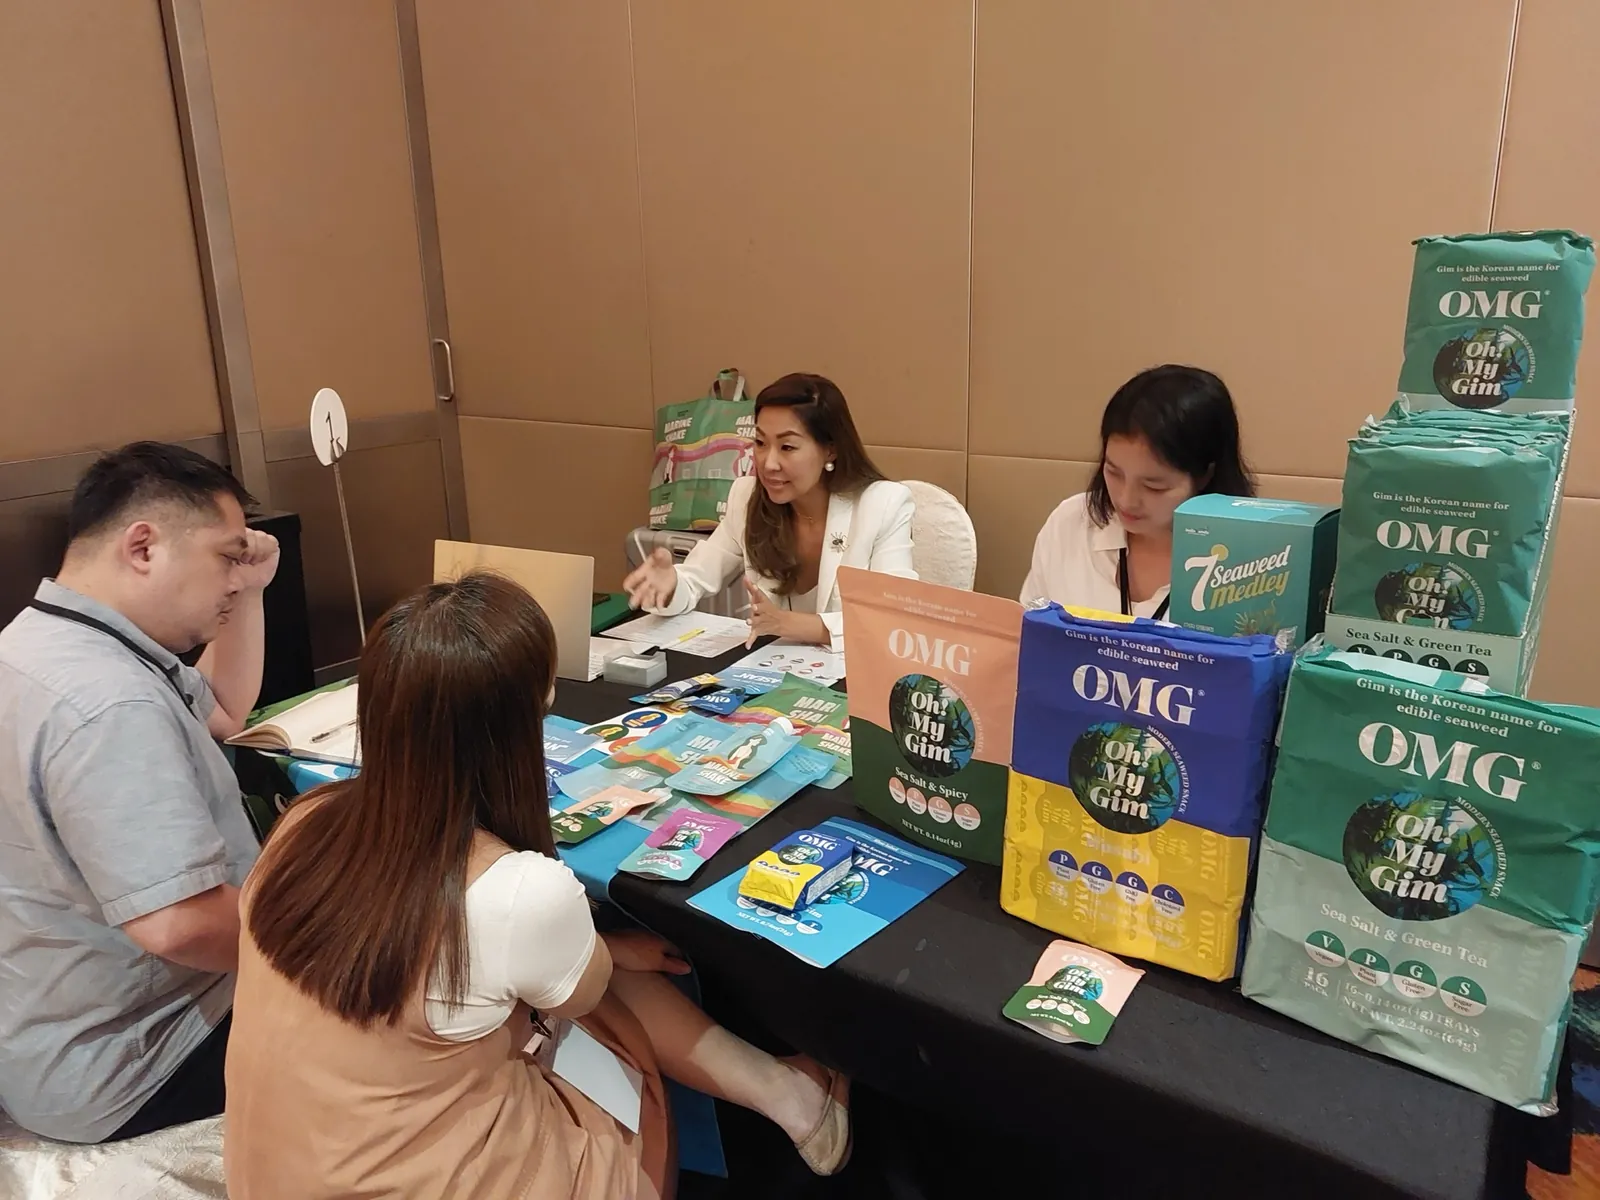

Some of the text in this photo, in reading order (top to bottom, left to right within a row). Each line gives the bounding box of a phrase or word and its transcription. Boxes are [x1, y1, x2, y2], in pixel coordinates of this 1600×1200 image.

[1436, 265, 1454, 273] Gim
[1462, 274, 1529, 282] edible seaweed
[1466, 341, 1504, 358] Oh!
[1462, 360, 1499, 380] My
[1452, 378, 1502, 396] Gim
[1373, 492, 1510, 511] Gim is the Korean name for
[1400, 505, 1476, 519] edible seaweed
[1184, 545, 1291, 612] 7 Seaweed
[1408, 576, 1449, 594] Oh!
[1404, 593, 1445, 614] My
[1065, 629, 1215, 666] Gim is the Korean name for
[1346, 627, 1492, 657] Sea Salt & Green Tea
[1097, 647, 1179, 671] edible seaweed
[1428, 657, 1439, 668] G
[1467, 662, 1476, 673] S
[910, 690, 949, 717] Oh!
[1356, 677, 1562, 736] Gim is the Korean name for
[908, 710, 946, 742] My
[1396, 702, 1509, 738] edible seaweed
[904, 733, 952, 763] Gim
[1105, 740, 1150, 768] Oh!
[895, 766, 968, 802] Sea Salt & Spicy
[1098, 762, 1146, 797] My
[1146, 724, 1190, 814] MODERN SEAWEED SNACK
[1090, 786, 1150, 820] Gim
[901, 819, 913, 830] NET
[1396, 814, 1459, 845] Oh!
[798, 834, 838, 851] OMG
[1455, 796, 1507, 900] MODERN SEAWEED SNACK
[1384, 839, 1446, 877] My
[1059, 854, 1174, 900] P G G C
[1370, 866, 1448, 903] Gim
[1321, 904, 1488, 969] Sea Salt & Green Tea
[1304, 966, 1329, 988] 16
[1314, 951, 1334, 963] Vegan
[1402, 979, 1425, 992] Gluten
[1452, 995, 1473, 1008] Sugar
[1322, 935, 1471, 996] V P G S
[1304, 982, 1328, 998] PACK
[1342, 996, 1367, 1015] NET
[1405, 986, 1421, 995] Free
[1453, 1002, 1470, 1013] Free
